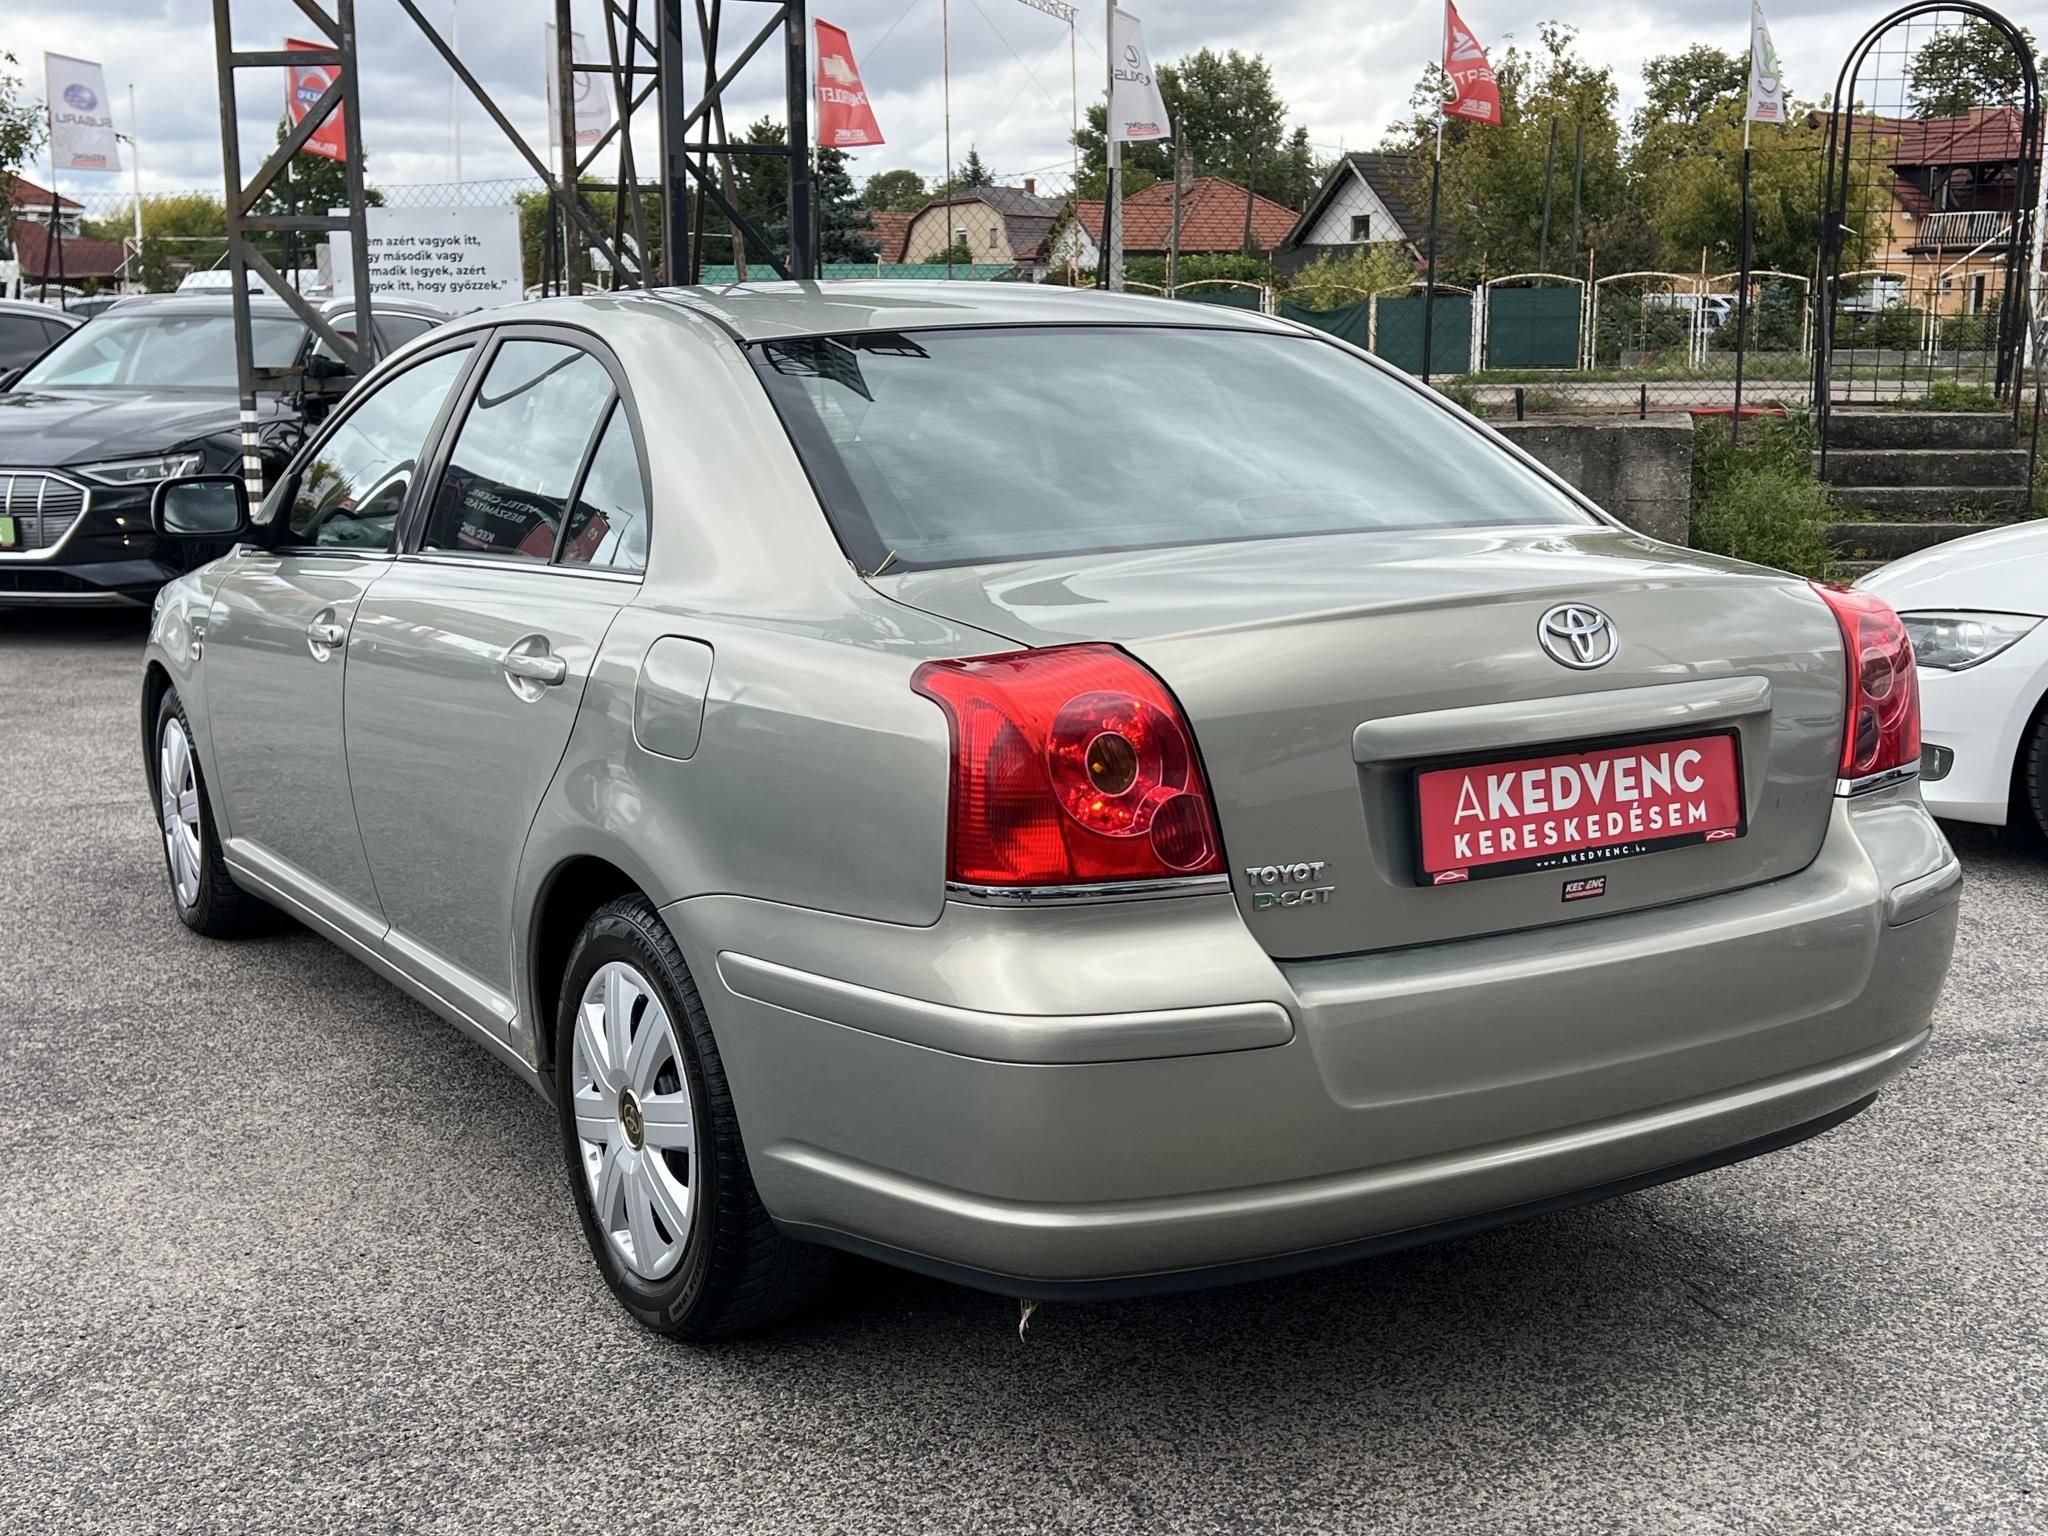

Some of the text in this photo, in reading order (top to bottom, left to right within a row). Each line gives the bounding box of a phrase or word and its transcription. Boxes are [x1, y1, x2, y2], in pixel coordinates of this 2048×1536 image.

[386, 236, 415, 246] azért
[418, 236, 461, 247] vagyok
[383, 250, 433, 261] második
[435, 252, 465, 263] vagy
[410, 264, 453, 277] legyek,
[456, 265, 487, 276] azért
[417, 280, 447, 292] hogy
[1454, 800, 1708, 859] KERESKEDÉSEM
[1253, 885, 1336, 911] D-CAT
